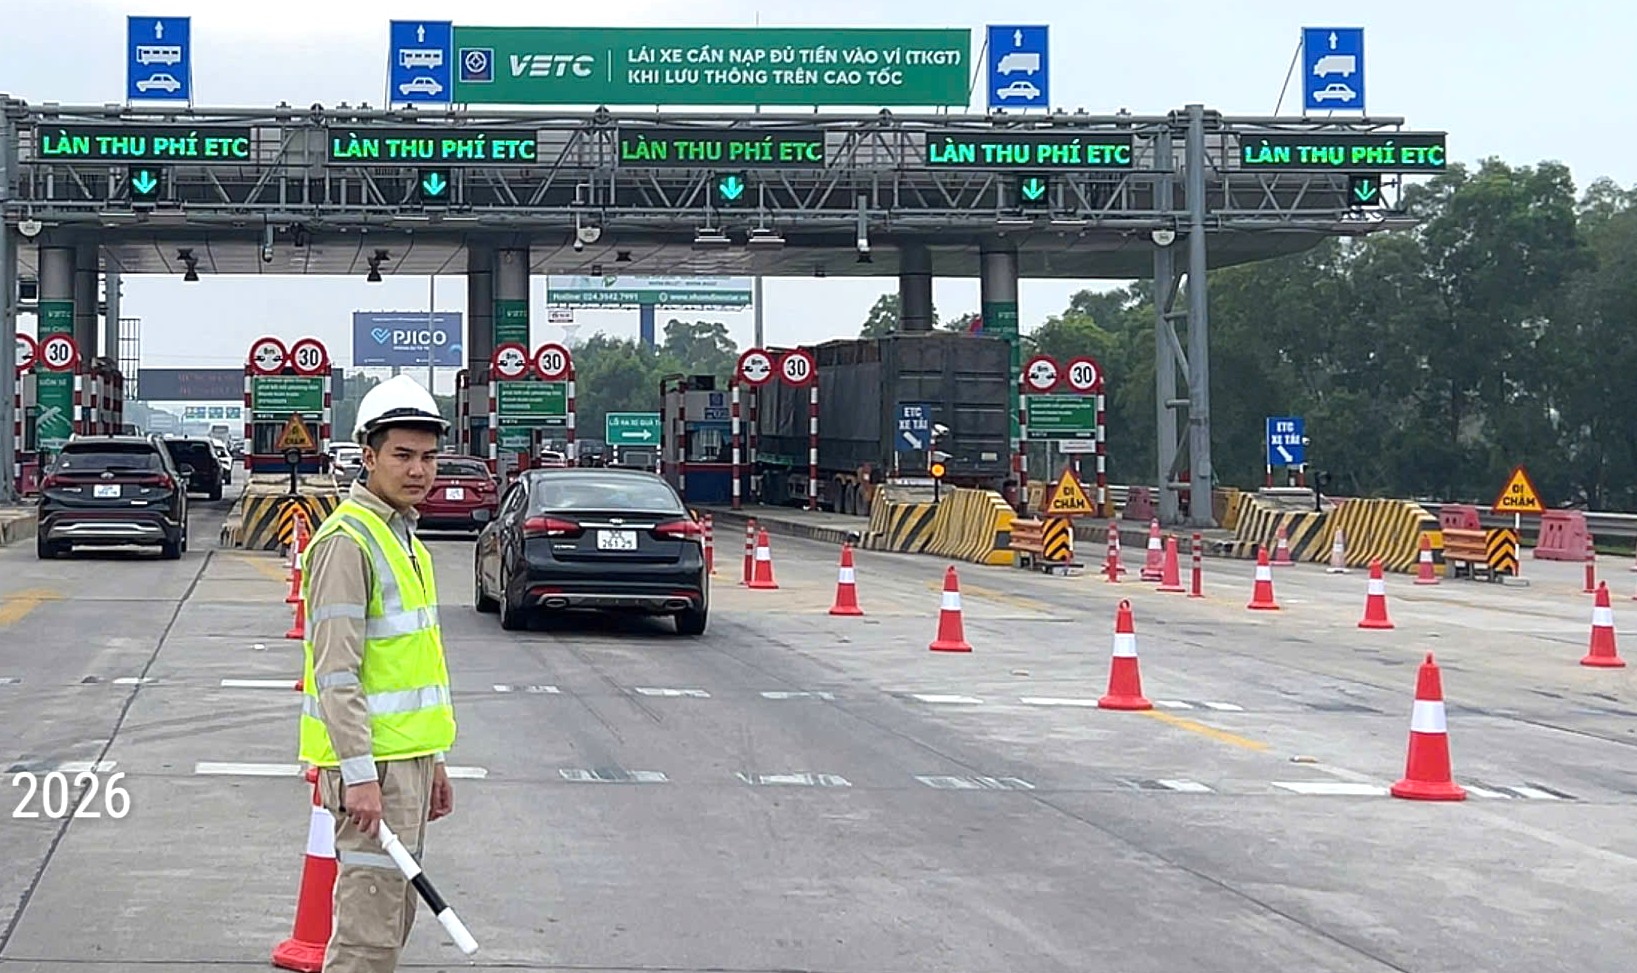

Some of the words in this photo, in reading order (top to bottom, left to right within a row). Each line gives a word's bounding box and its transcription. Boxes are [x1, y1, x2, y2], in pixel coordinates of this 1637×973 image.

[628, 45, 655, 63] LÁI
[659, 49, 683, 63] XE
[729, 48, 766, 67] NẠP
[770, 45, 795, 63] ĐỦ
[842, 46, 878, 64] VÀO
[882, 47, 901, 65] VÍ
[905, 49, 961, 66] (TKGT)
[510, 54, 595, 77] VETC
[628, 69, 659, 84] KHI
[665, 68, 699, 84] LƯU
[704, 66, 768, 84] THÔNG
[772, 66, 818, 84] TRÊN
[824, 70, 862, 85] CAO
[866, 66, 903, 85] TỐC
[43, 129, 90, 155] LÀN
[95, 136, 146, 156] THU
[153, 131, 199, 156] PHÍ
[204, 137, 249, 157] ETC
[333, 132, 380, 158] LÀN
[385, 139, 434, 159] THU
[442, 133, 485, 159] PHÍ
[492, 140, 536, 159] ETC
[621, 134, 667, 160] LÀN
[673, 141, 721, 161] THU
[729, 135, 773, 161] PHÍ
[779, 142, 823, 161] ETC
[929, 137, 975, 163] LÀN
[981, 144, 1030, 164] THU
[1037, 138, 1081, 164] PHÍ
[1087, 145, 1131, 164] ETC
[1244, 139, 1290, 163] LÀN
[1296, 146, 1345, 165] THU
[1352, 140, 1396, 164] PHÍ
[1401, 145, 1445, 166] ETC
[393, 330, 447, 345] PJICO
[49, 343, 69, 361] 30
[299, 348, 319, 366] 30
[543, 353, 562, 370] 30
[787, 359, 806, 376] 30
[1073, 366, 1092, 384] 30
[903, 406, 922, 417] ETC
[898, 419, 911, 430] XE
[1276, 421, 1295, 433] ETC
